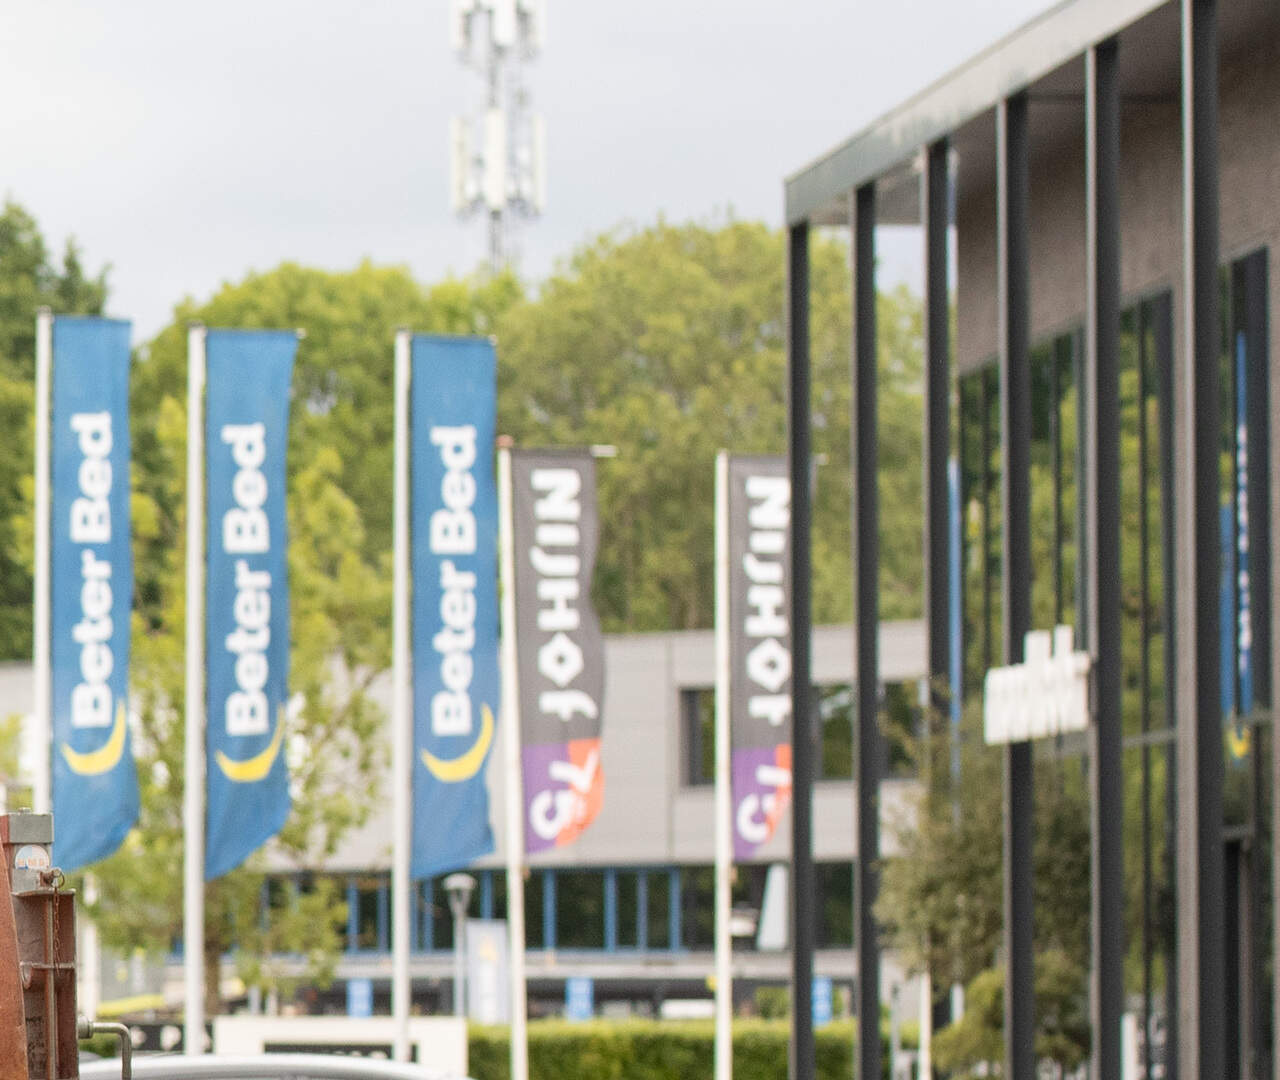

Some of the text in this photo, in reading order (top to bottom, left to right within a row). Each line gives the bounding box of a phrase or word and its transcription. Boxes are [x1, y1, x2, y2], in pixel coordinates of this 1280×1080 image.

[70, 411, 114, 728] Beter Bed
[220, 422, 272, 736] Beter Bed
[430, 425, 477, 736] Beter Bed
[529, 468, 598, 720] NIJHOF
[743, 476, 792, 726] NIJHOF
